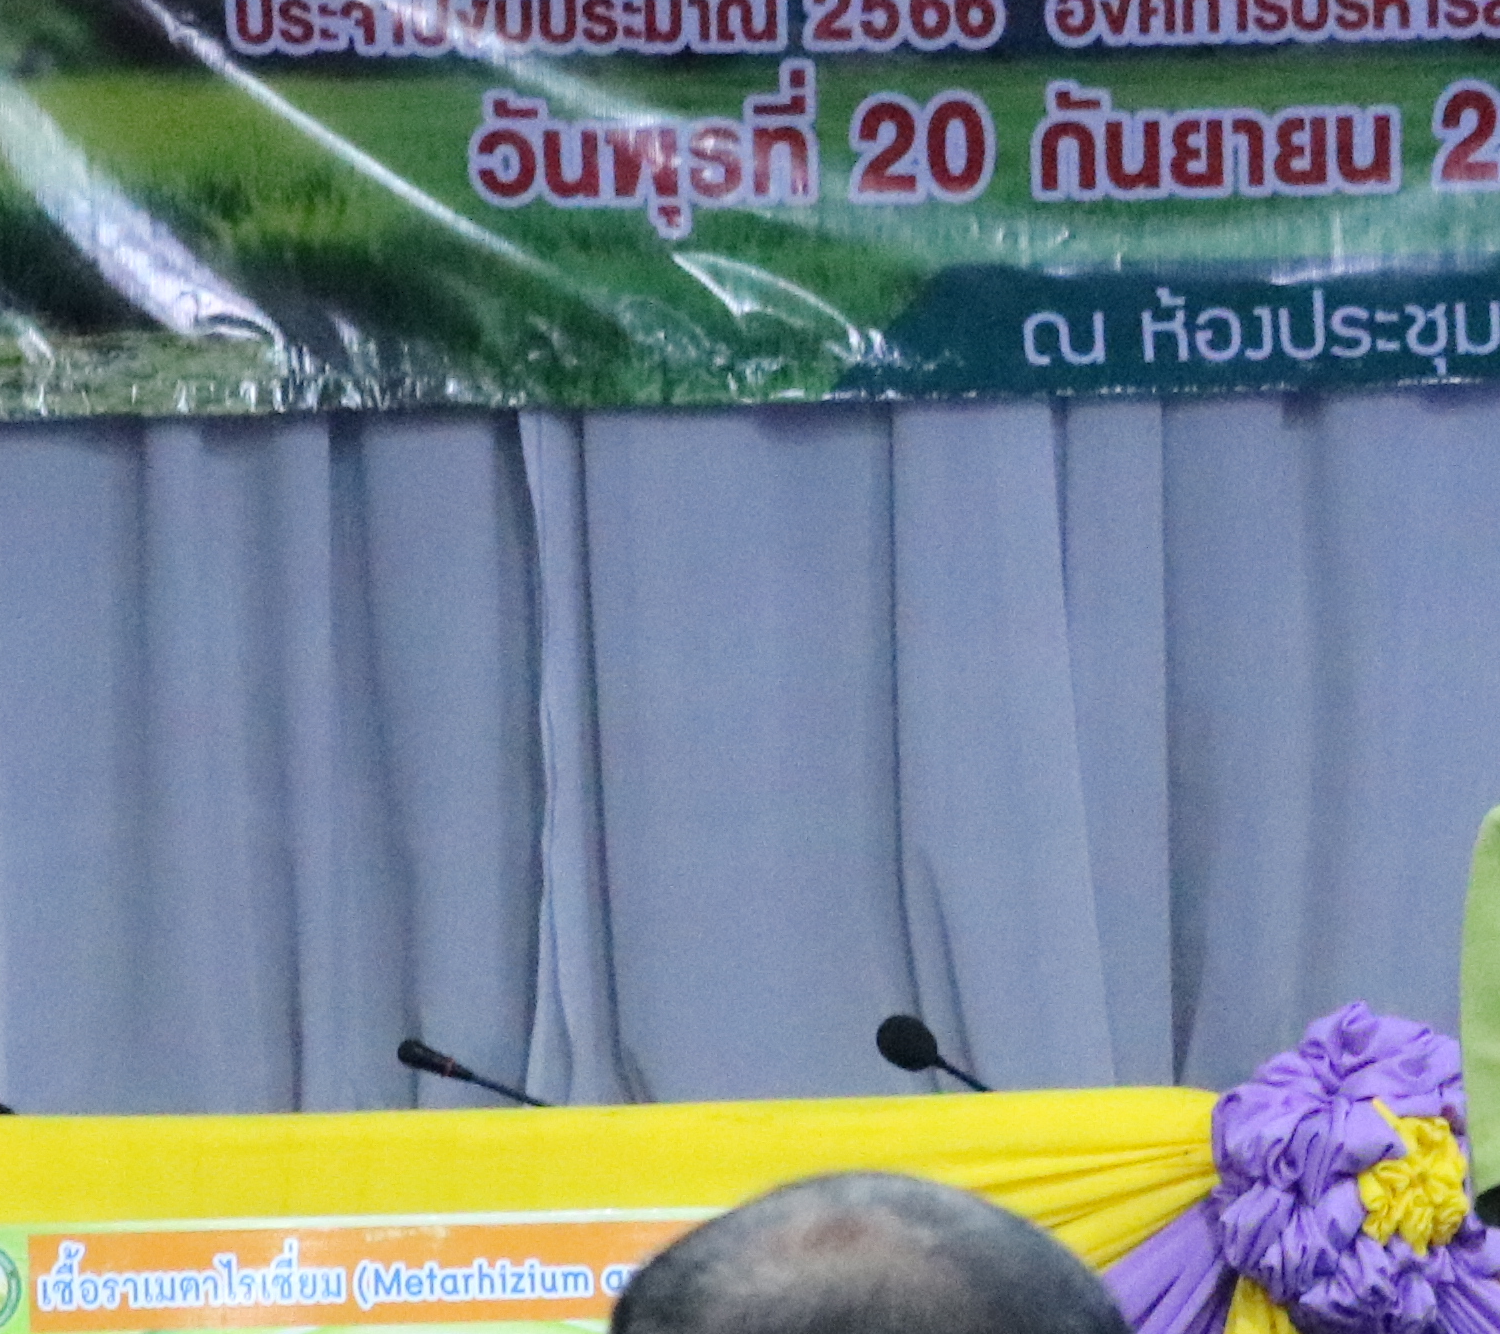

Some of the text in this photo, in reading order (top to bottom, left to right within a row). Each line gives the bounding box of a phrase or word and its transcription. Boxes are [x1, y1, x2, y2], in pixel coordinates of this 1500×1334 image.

[476, 69, 810, 228] วันพุธที่
[856, 99, 987, 197] 20
[1039, 92, 1392, 192] กันยายน
[1022, 311, 1106, 366] ณ
[358, 1263, 590, 1307] (Metarhizium
